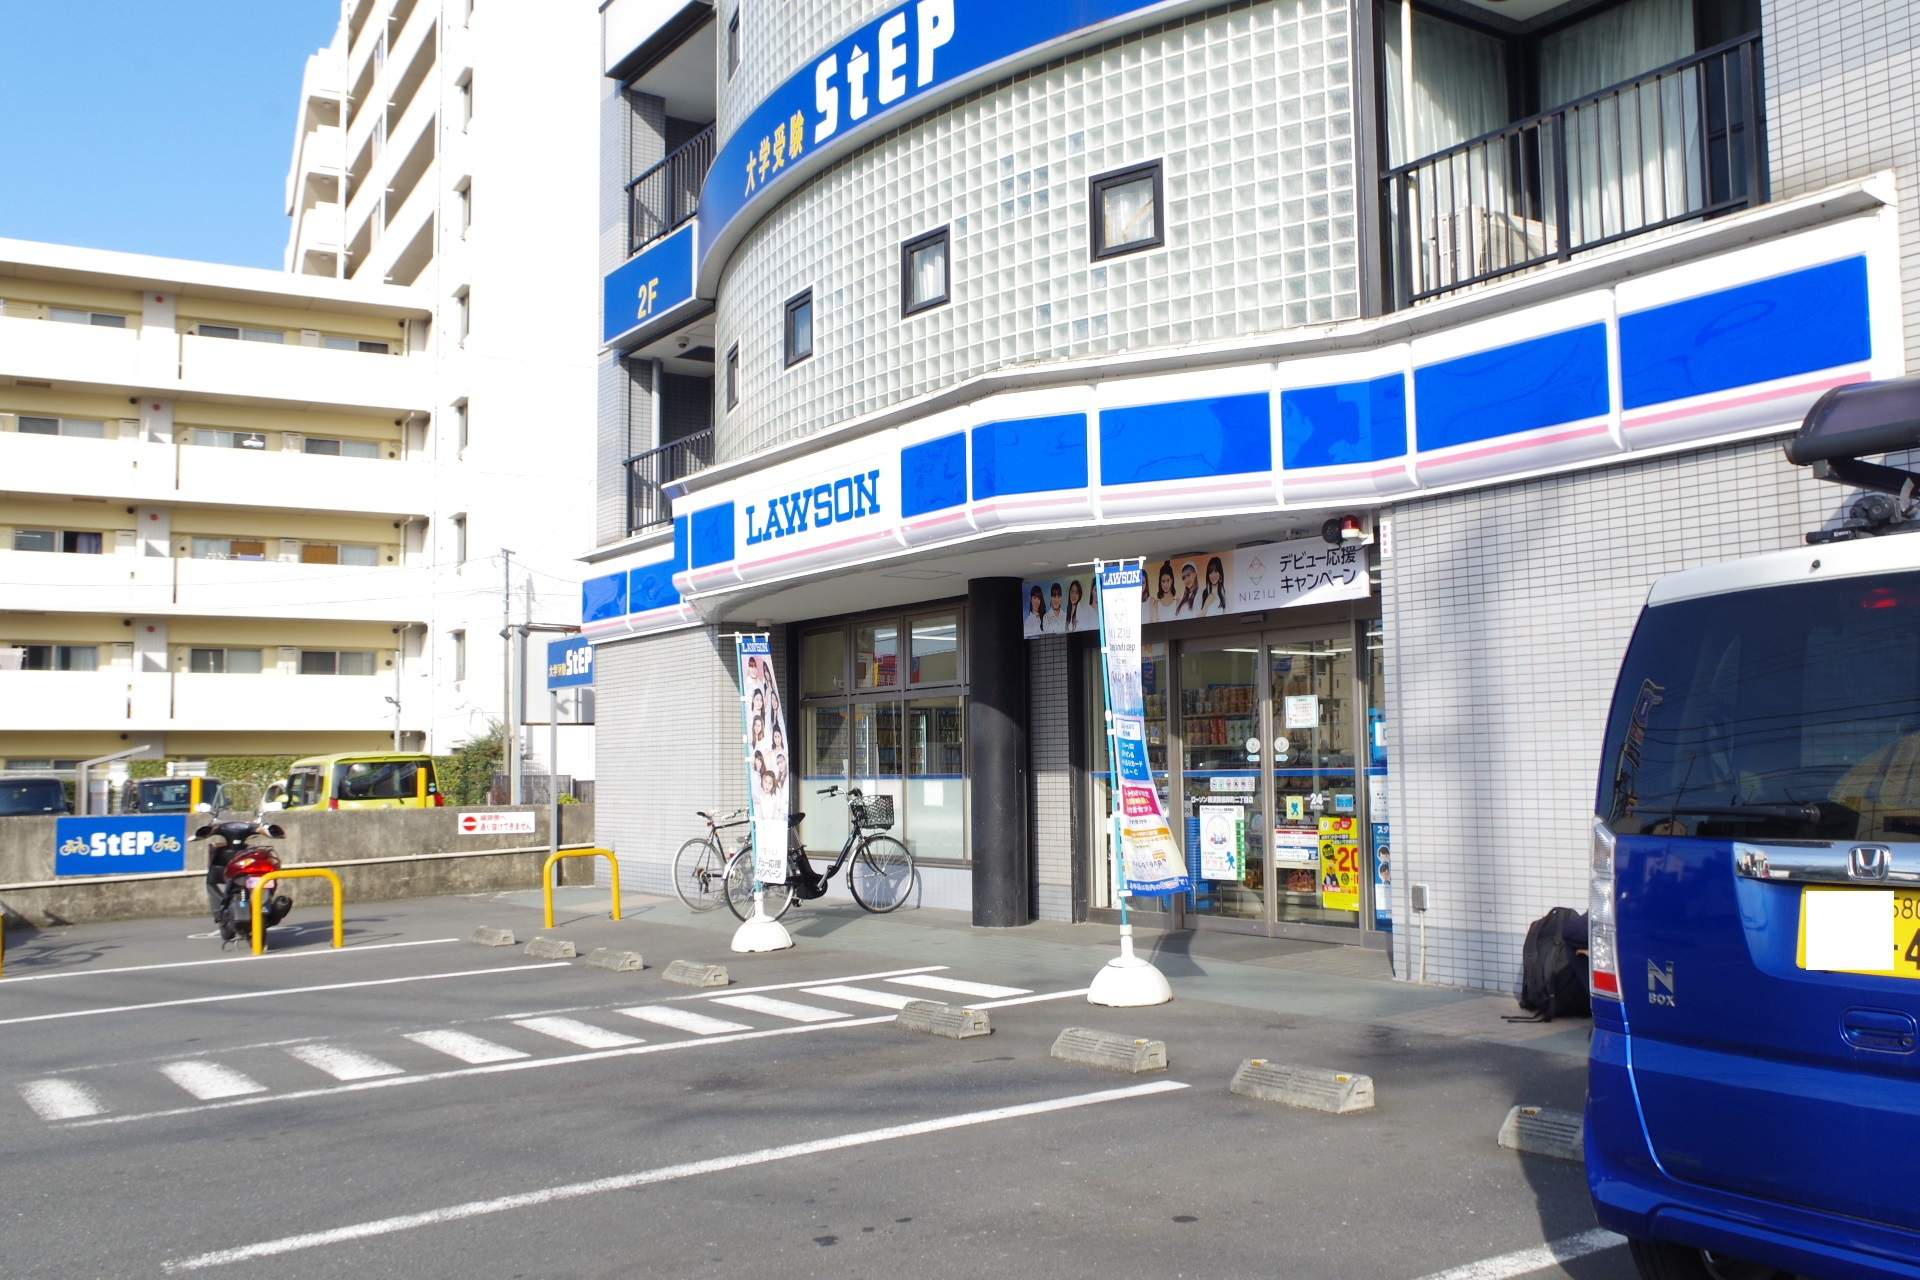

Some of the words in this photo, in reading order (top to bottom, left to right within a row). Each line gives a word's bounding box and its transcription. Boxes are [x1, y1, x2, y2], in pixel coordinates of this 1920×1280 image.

[744, 110, 804, 198] 大学受験
[637, 277, 659, 320] 2F
[746, 468, 881, 546] LAWSON
[1280, 545, 1357, 573] デビュー応援
[1103, 570, 1141, 586] LAWSON
[1280, 568, 1356, 594] キャンペーン
[741, 642, 769, 653] LAWSON
[1647, 957, 1675, 993] N
[1648, 993, 1676, 1007] BOX
